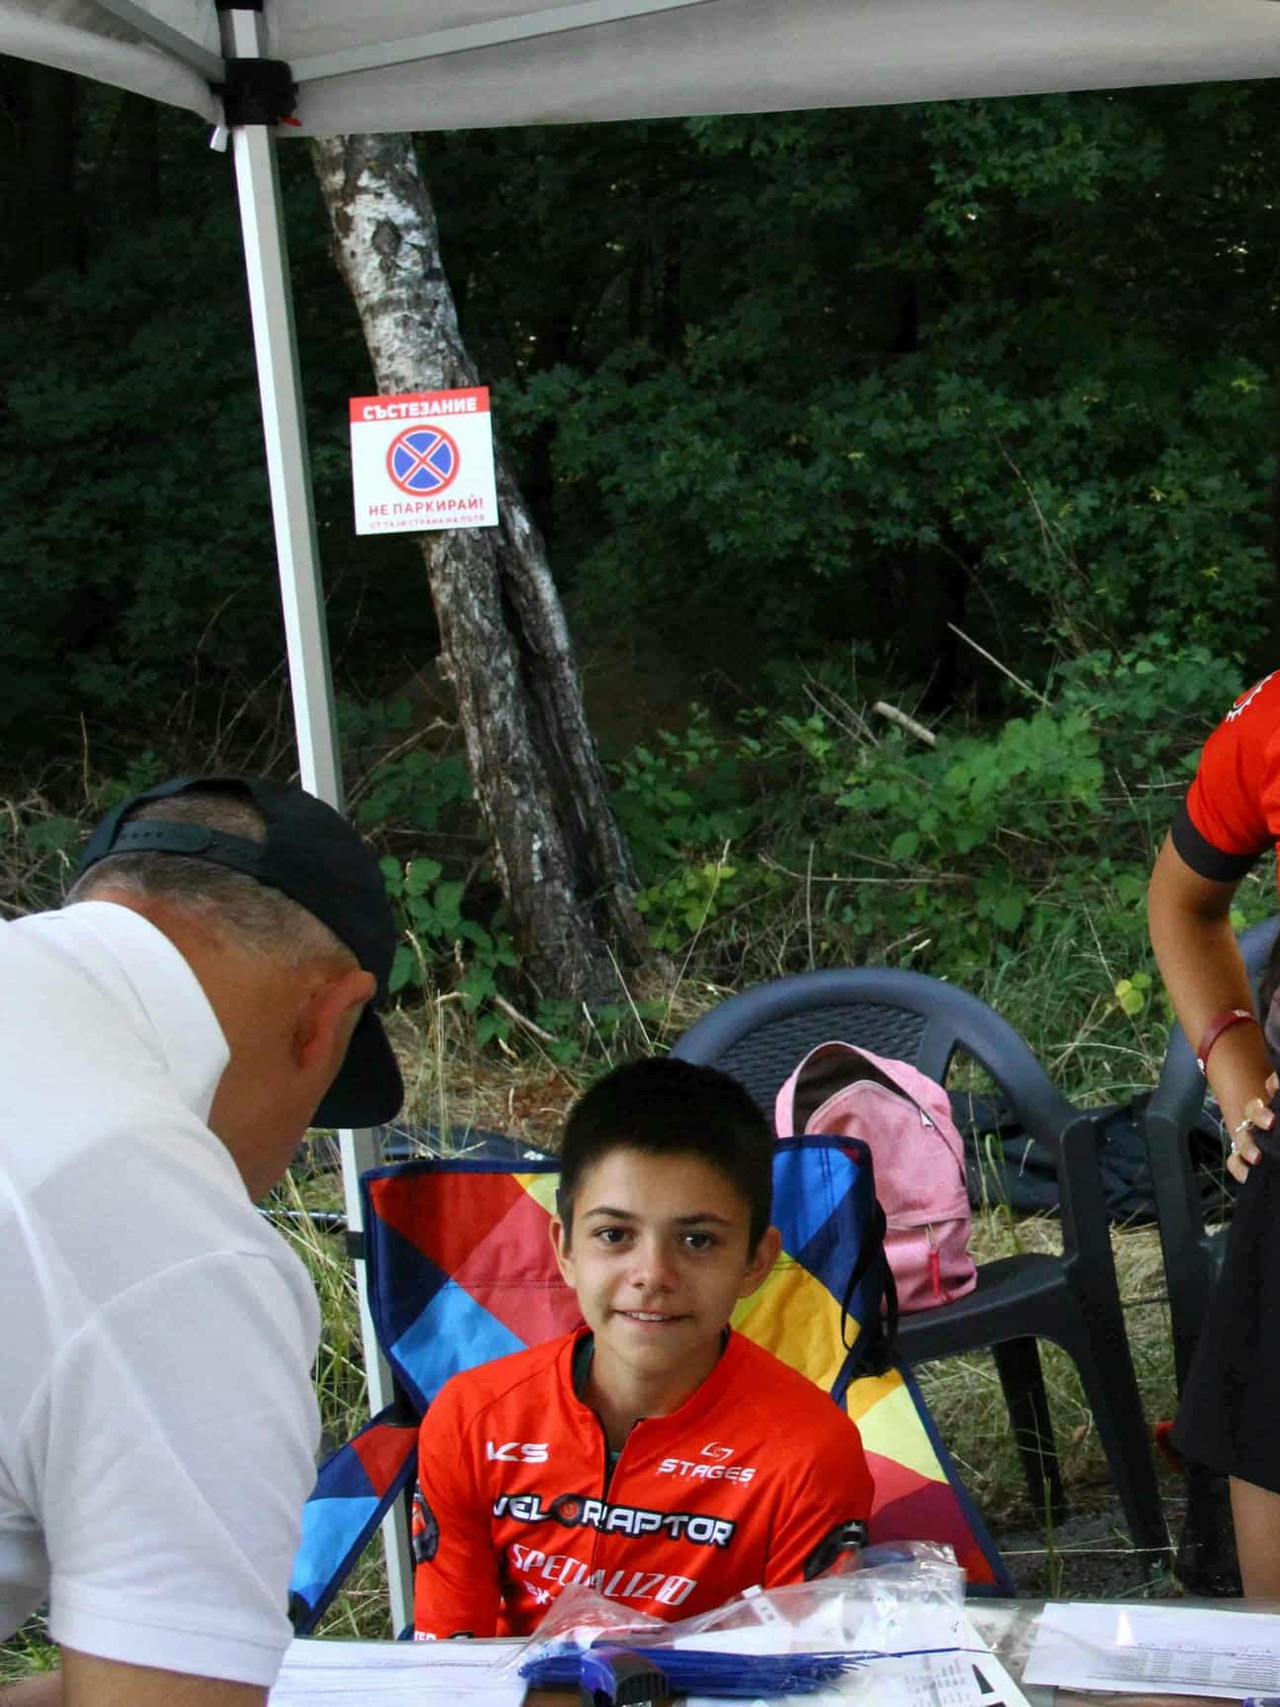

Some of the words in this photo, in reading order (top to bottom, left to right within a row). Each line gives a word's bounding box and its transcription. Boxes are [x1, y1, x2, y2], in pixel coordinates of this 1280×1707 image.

[363, 397, 477, 420] СЪСТЕЗАНИЕ
[369, 505, 388, 516] НЕ
[393, 495, 483, 514] ПАРКИРАЙ!
[486, 1440, 550, 1464] KS
[658, 1458, 757, 1483] STAGES
